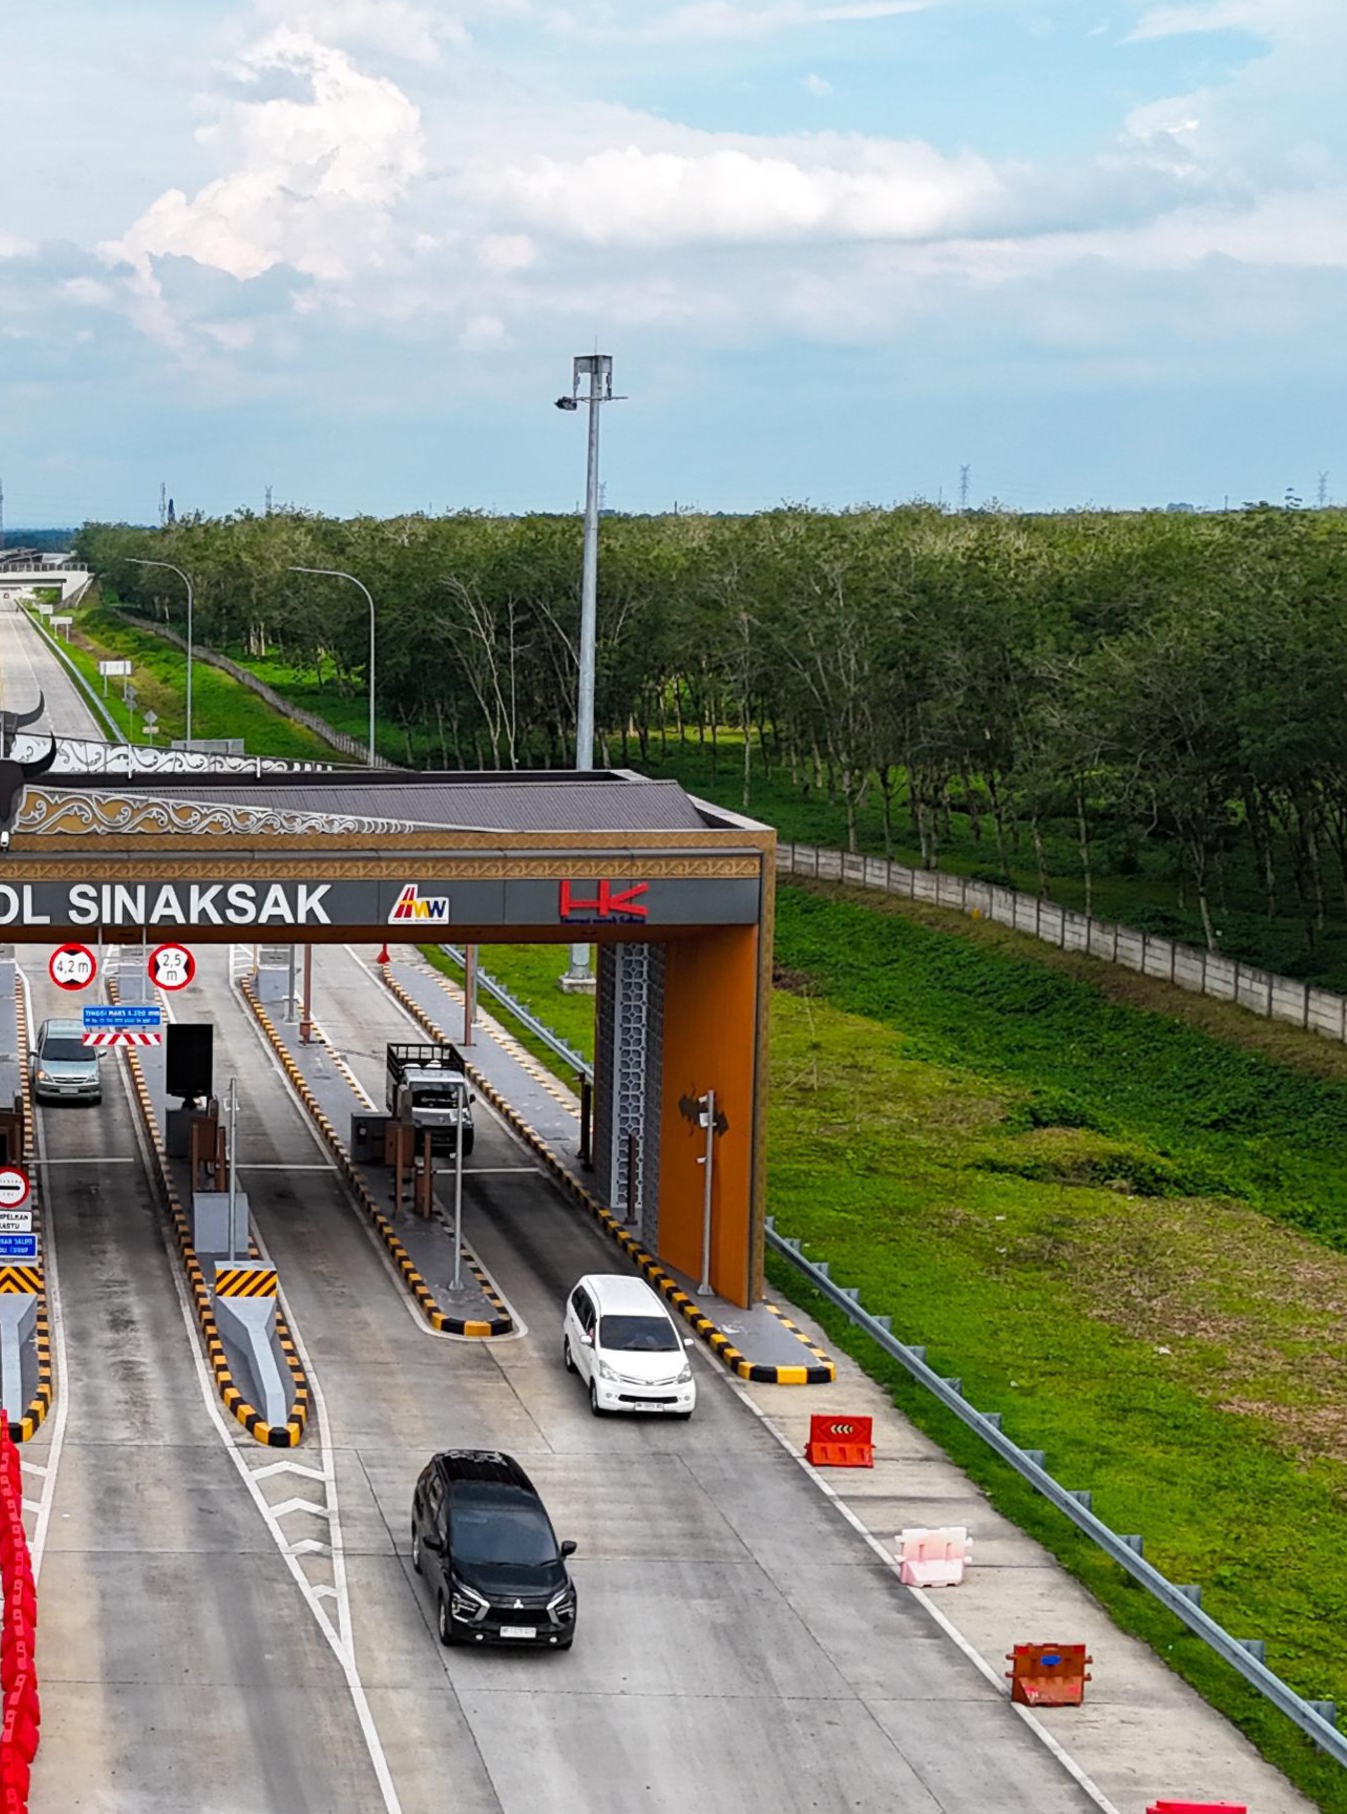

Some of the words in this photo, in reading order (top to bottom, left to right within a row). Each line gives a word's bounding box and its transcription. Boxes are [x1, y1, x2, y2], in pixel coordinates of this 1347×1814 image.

[67, 883, 333, 925] SINAKSAK
[559, 879, 649, 917] HK
[56, 959, 75, 974] 4,2
[78, 961, 89, 973] m
[162, 953, 181, 967] 2,5
[166, 970, 178, 981] m
